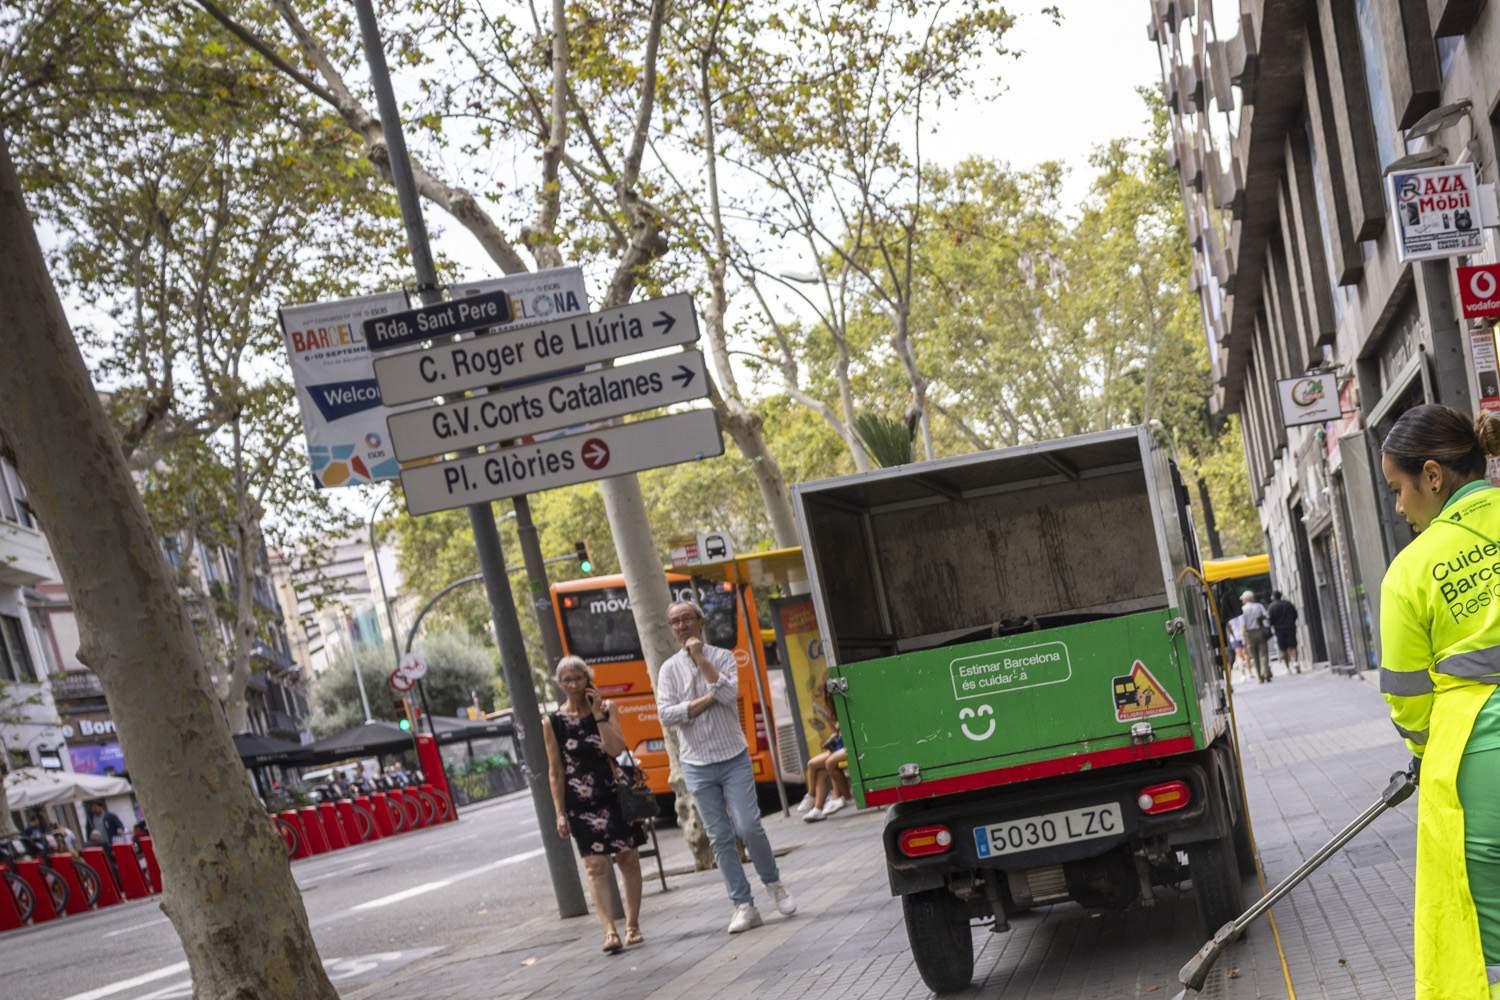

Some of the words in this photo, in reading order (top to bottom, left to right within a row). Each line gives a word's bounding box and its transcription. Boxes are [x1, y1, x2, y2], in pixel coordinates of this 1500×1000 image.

[375, 319, 414, 341] Rda.
[417, 307, 456, 332] Sant
[458, 301, 497, 323] Pere
[511, 290, 580, 321] ELONA
[291, 323, 364, 353] BARCEL
[420, 356, 446, 383] C.
[452, 341, 524, 376] Roger
[534, 330, 563, 359] de
[571, 313, 643, 350] Llúria
[432, 405, 478, 439] G.V.
[480, 395, 543, 429] Corts
[549, 372, 663, 413] Catalanes
[444, 464, 477, 494] Pl.
[484, 448, 575, 486] Glòries
[590, 598, 632, 614] mov
[959, 662, 1000, 678] Estimar
[1003, 651, 1060, 669] Barcelona
[962, 679, 976, 691] és
[990, 820, 1056, 851] 5030
[1065, 809, 1115, 839] LZC
